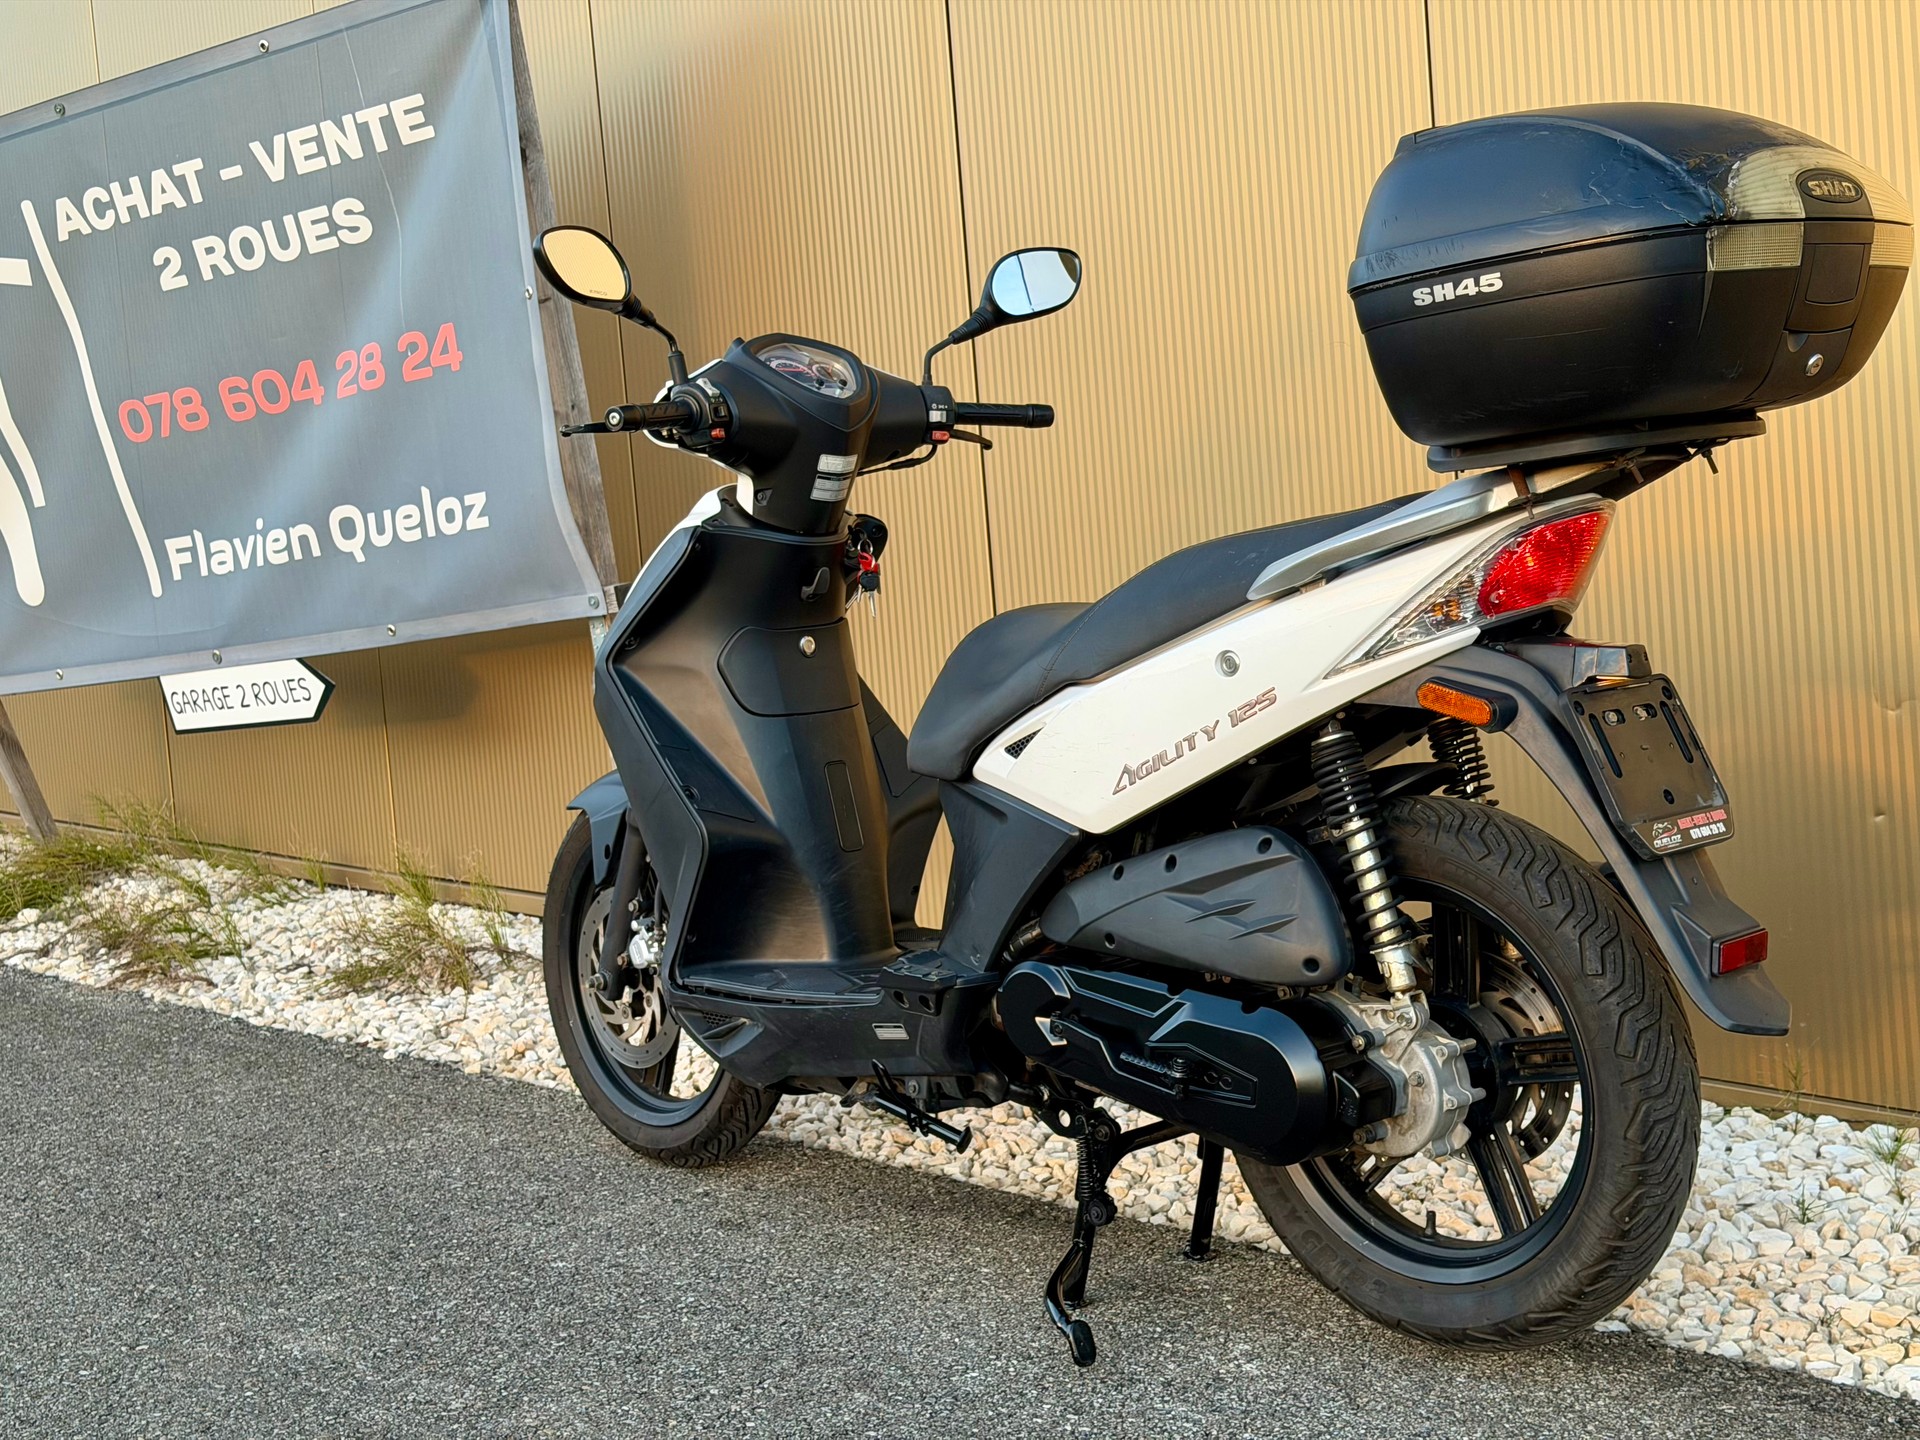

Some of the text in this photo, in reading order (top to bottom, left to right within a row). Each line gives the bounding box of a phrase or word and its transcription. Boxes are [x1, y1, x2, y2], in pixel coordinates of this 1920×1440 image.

[56, 158, 203, 241] ACHAT
[249, 94, 436, 183] VENTE
[1807, 180, 1856, 197] SHAD
[153, 198, 373, 291] 2 ROUES
[1412, 272, 1504, 306] SH45
[119, 323, 464, 442] 078 604 28 24
[165, 486, 490, 581] Flavien Queloz
[170, 678, 312, 714] GARAGE 2 ROUES
[1112, 686, 1278, 795] AGILITY 125
[1653, 834, 1682, 848] QUELOZ
